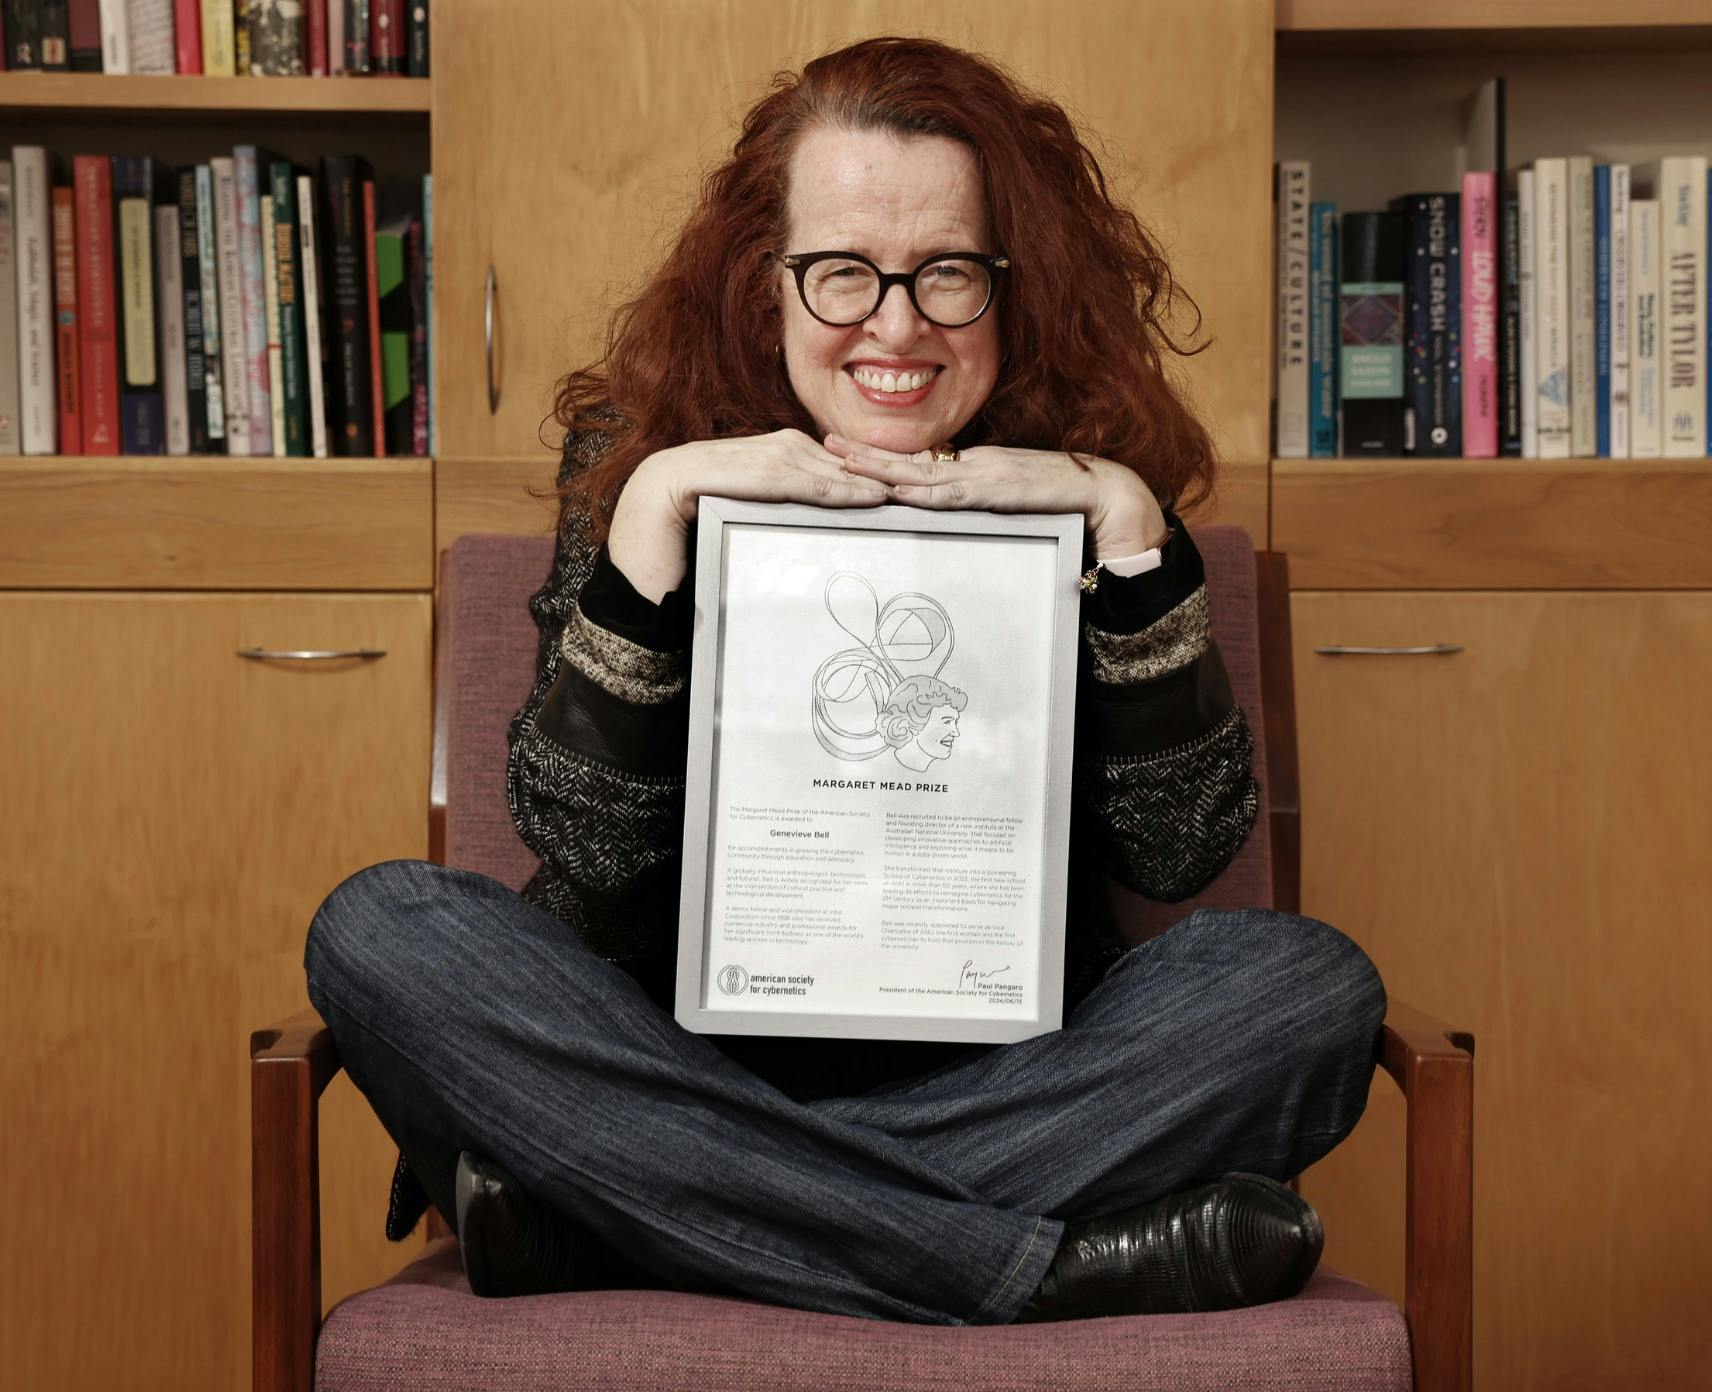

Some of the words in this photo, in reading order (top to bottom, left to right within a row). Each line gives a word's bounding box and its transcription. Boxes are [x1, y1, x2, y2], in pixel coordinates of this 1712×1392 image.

[1430, 196, 1445, 257] SNOW
[1289, 170, 1308, 366] STATE/CULTURE
[1471, 250, 1493, 301] LOUD
[1670, 249, 1697, 317] AFTER
[1430, 262, 1446, 331] CRASH
[1471, 304, 1493, 362] HAWK
[1670, 320, 1697, 390] TYLOR
[813, 779, 876, 789] MARGARET
[880, 781, 912, 791] MEAD
[915, 783, 949, 793] PRIZE
[770, 829, 812, 838] Genevieve
[814, 831, 830, 839] Bell
[750, 973, 786, 984] american
[787, 974, 815, 986] society
[750, 984, 760, 994] for
[762, 985, 807, 996] cybernetics
[879, 986, 907, 994] President
[926, 988, 955, 996] American
[988, 991, 1023, 999] Cybernetics
[978, 982, 992, 990] Paul
[994, 983, 1023, 992] Pangaro
